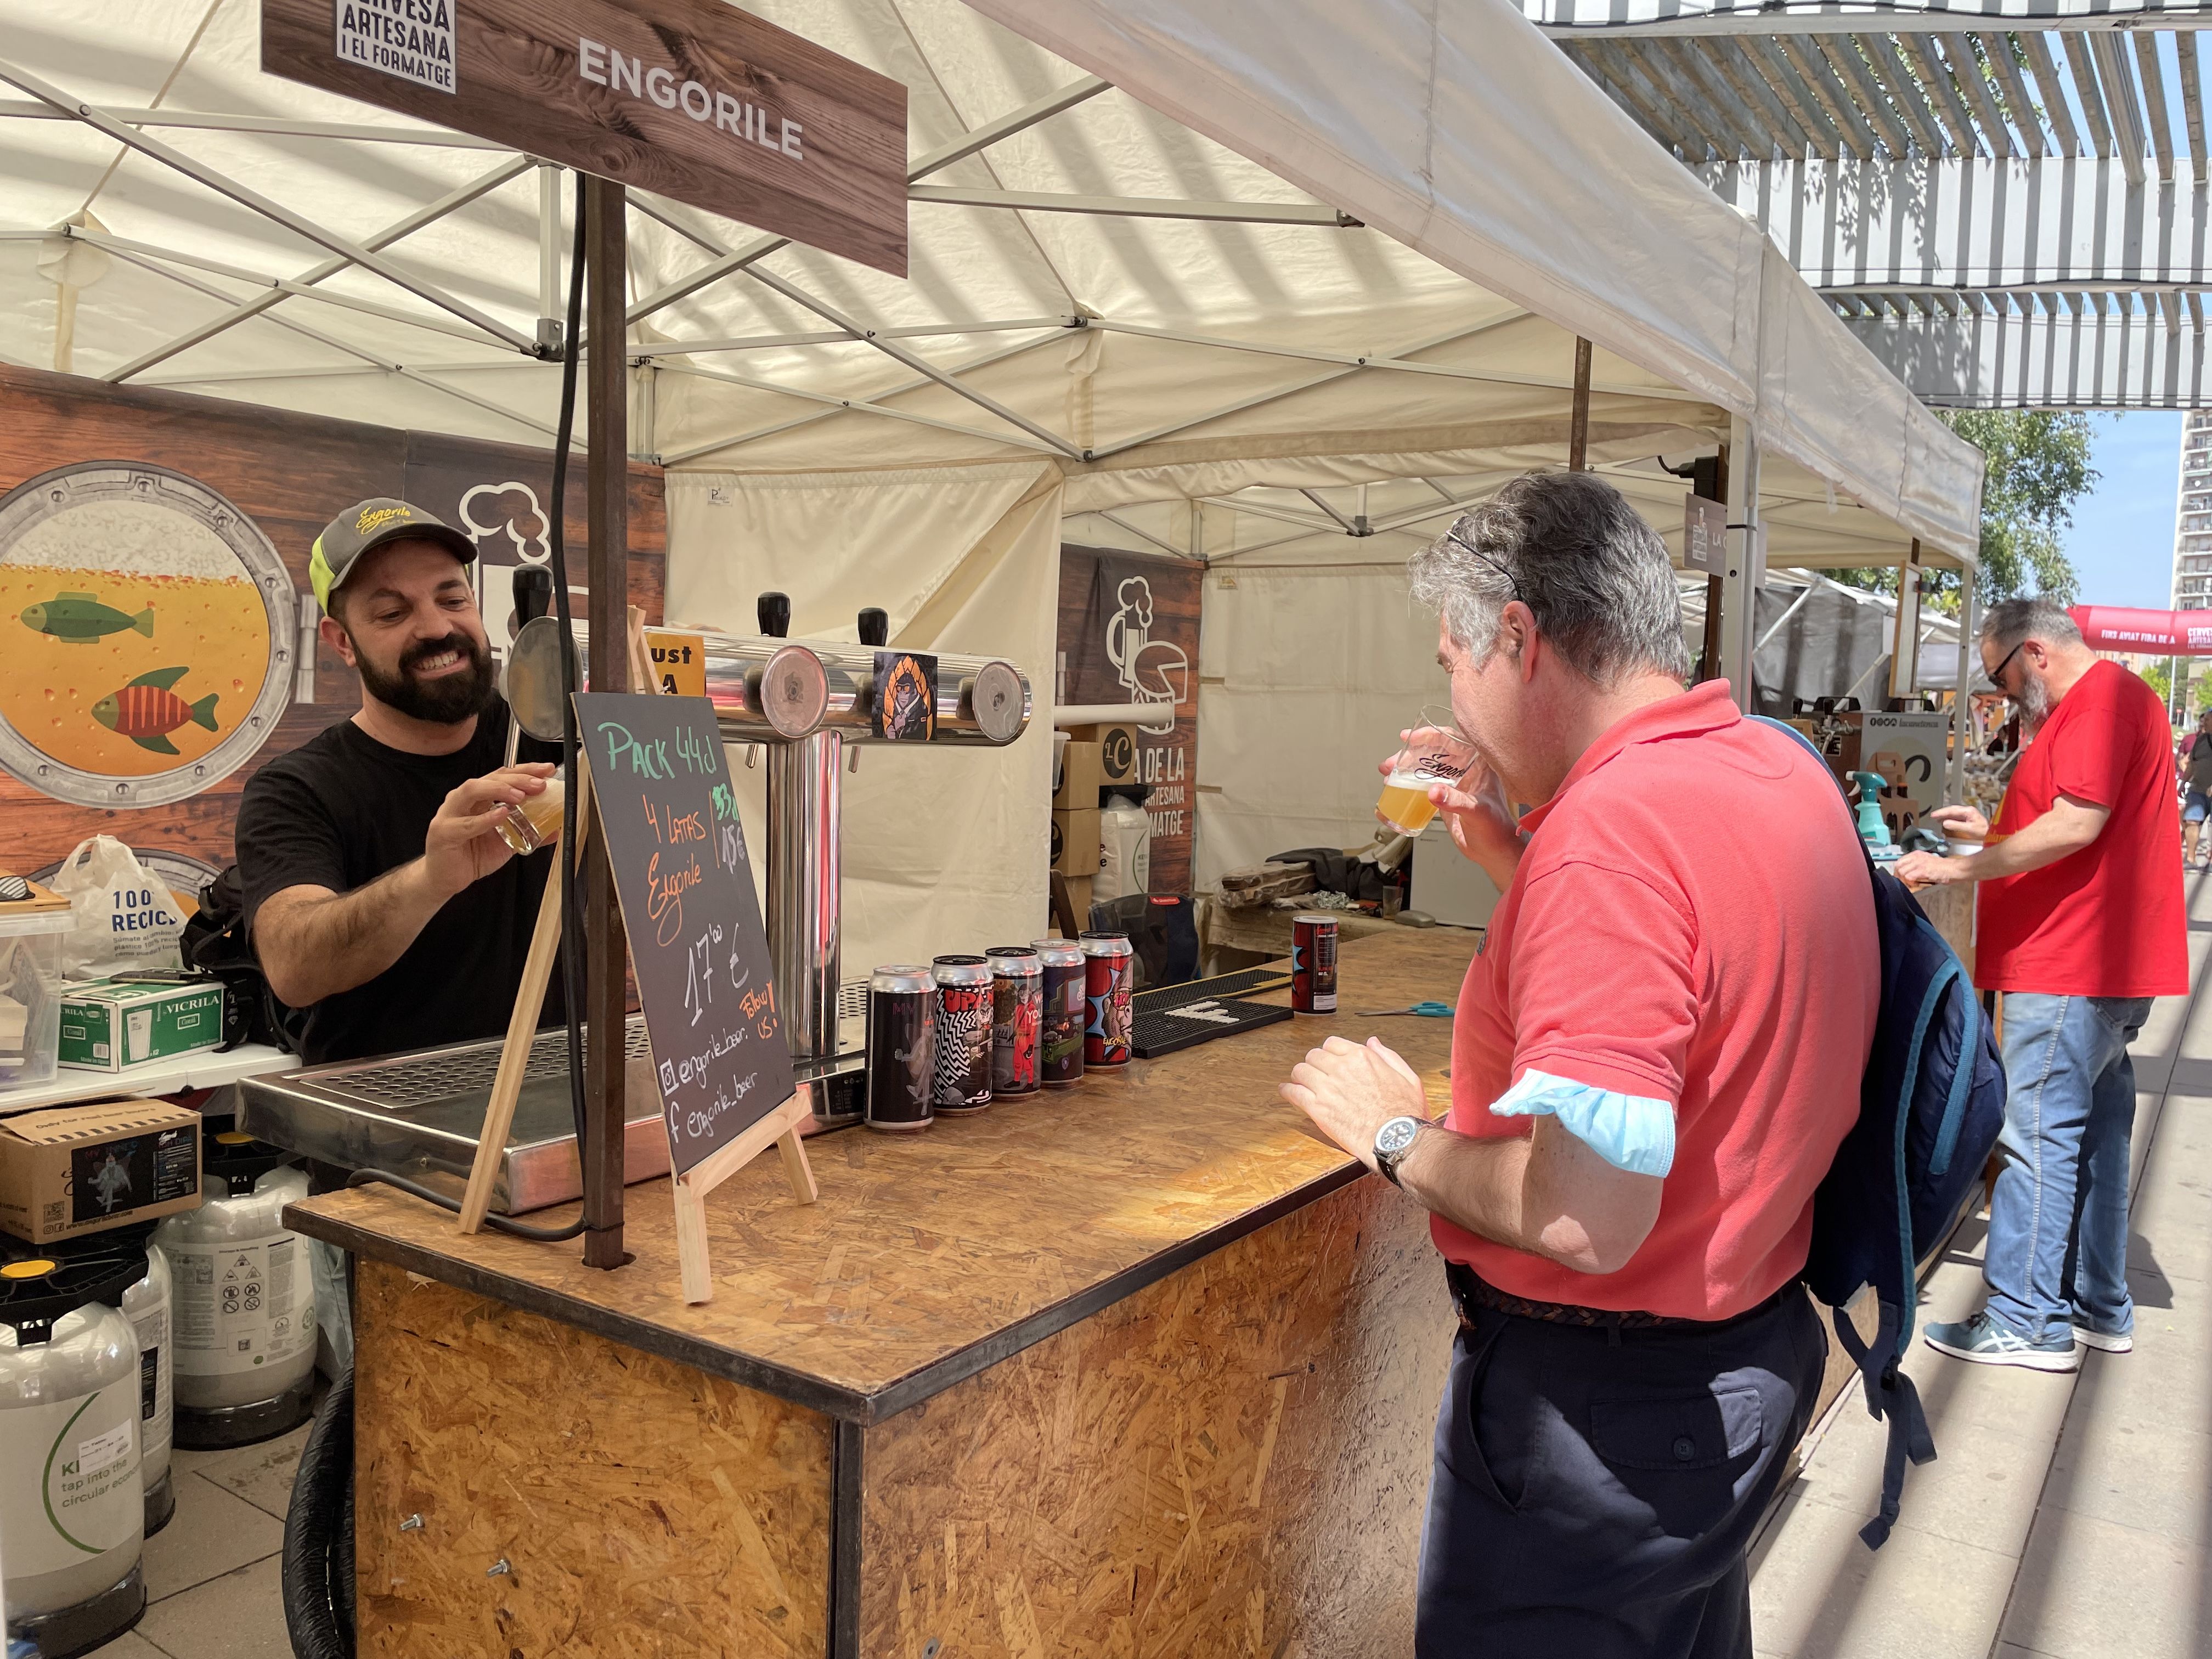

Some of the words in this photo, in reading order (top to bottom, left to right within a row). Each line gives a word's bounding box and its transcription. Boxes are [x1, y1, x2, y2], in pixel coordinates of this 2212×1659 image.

[358, 0, 450, 32] VESA
[342, 3, 451, 64] ARTESANA
[342, 33, 346, 54] I
[352, 37, 368, 60] EL
[373, 43, 451, 88] FORMATGE
[579, 36, 804, 161] ENGORILE
[1146, 748, 1164, 783] DE
[1167, 747, 1184, 781] LA
[642, 794, 662, 844] 4
[60, 1008, 83, 1016] CRILA
[166, 995, 219, 1014] VICRILA
[61, 1480, 83, 1492] tap
[87, 1469, 110, 1484] into
[112, 1459, 127, 1472] the
[61, 1484, 109, 1508] circular
